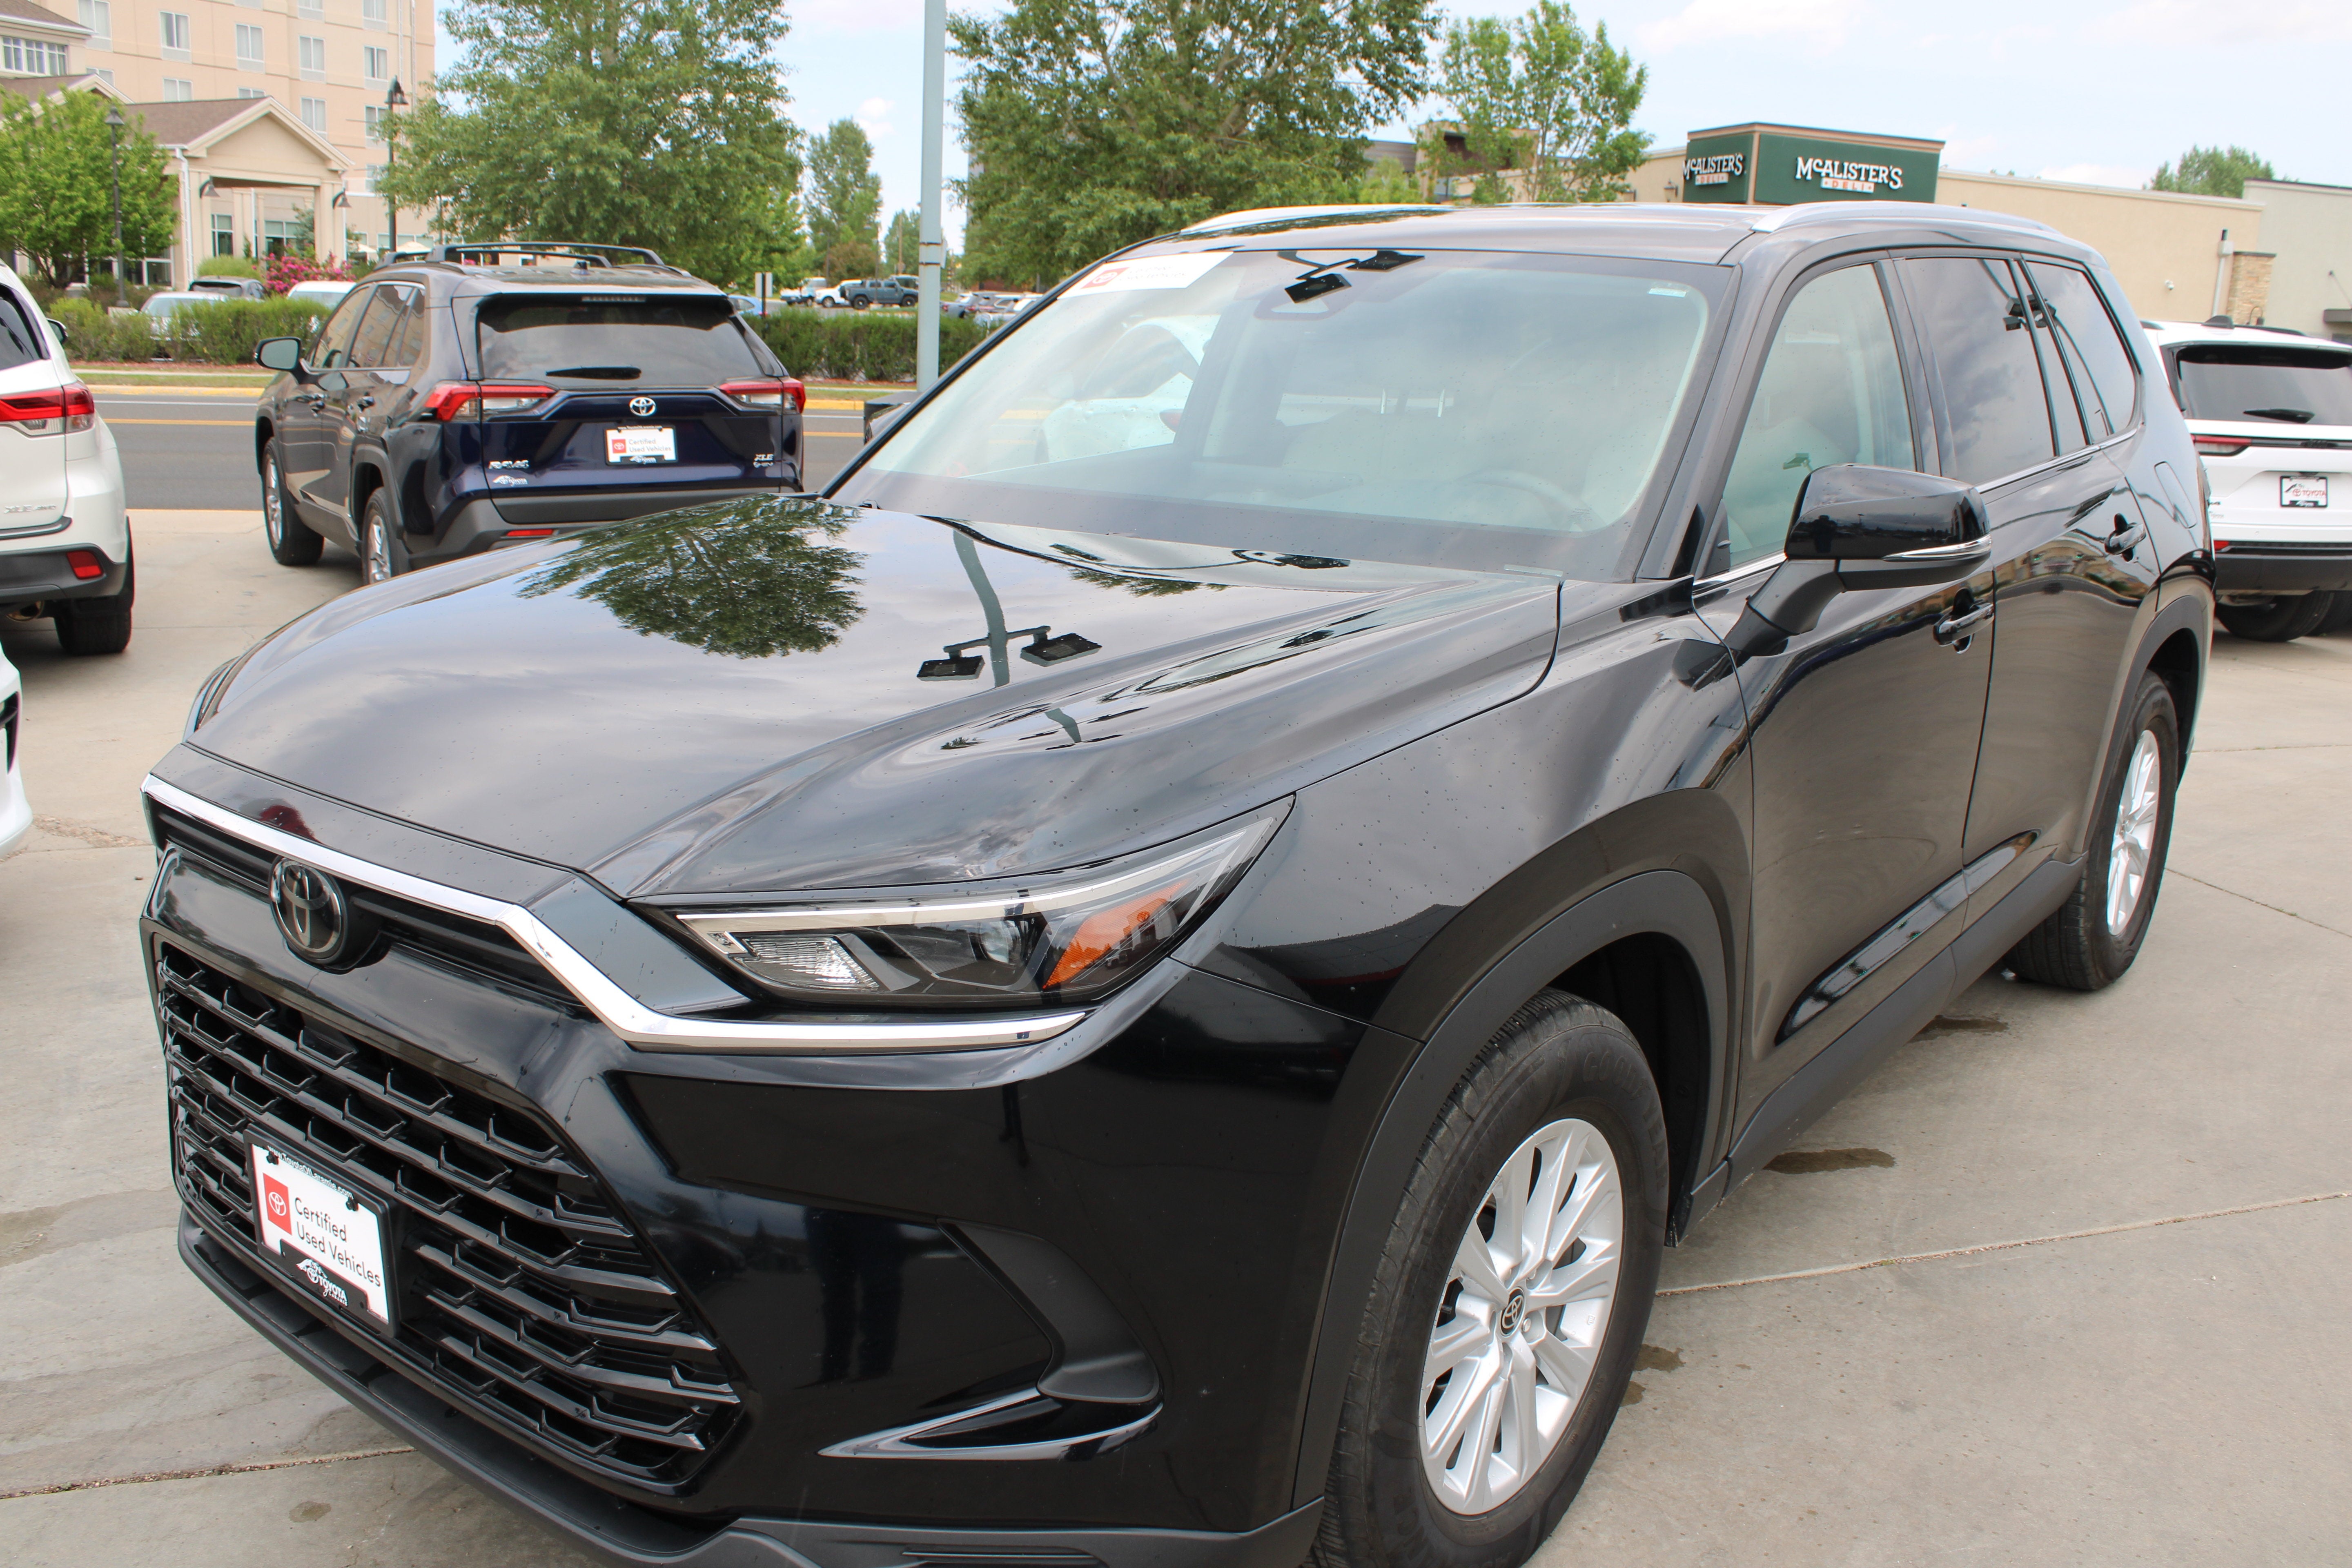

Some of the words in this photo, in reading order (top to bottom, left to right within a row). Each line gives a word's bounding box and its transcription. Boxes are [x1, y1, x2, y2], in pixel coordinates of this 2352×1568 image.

[1832, 180, 1865, 190] DELI
[4, 505, 33, 514] XLE
[295, 1197, 347, 1243] Certified
[297, 1221, 325, 1254] Used
[328, 1241, 381, 1287] Vehicles
[318, 1275, 347, 1301] TOYOTA
